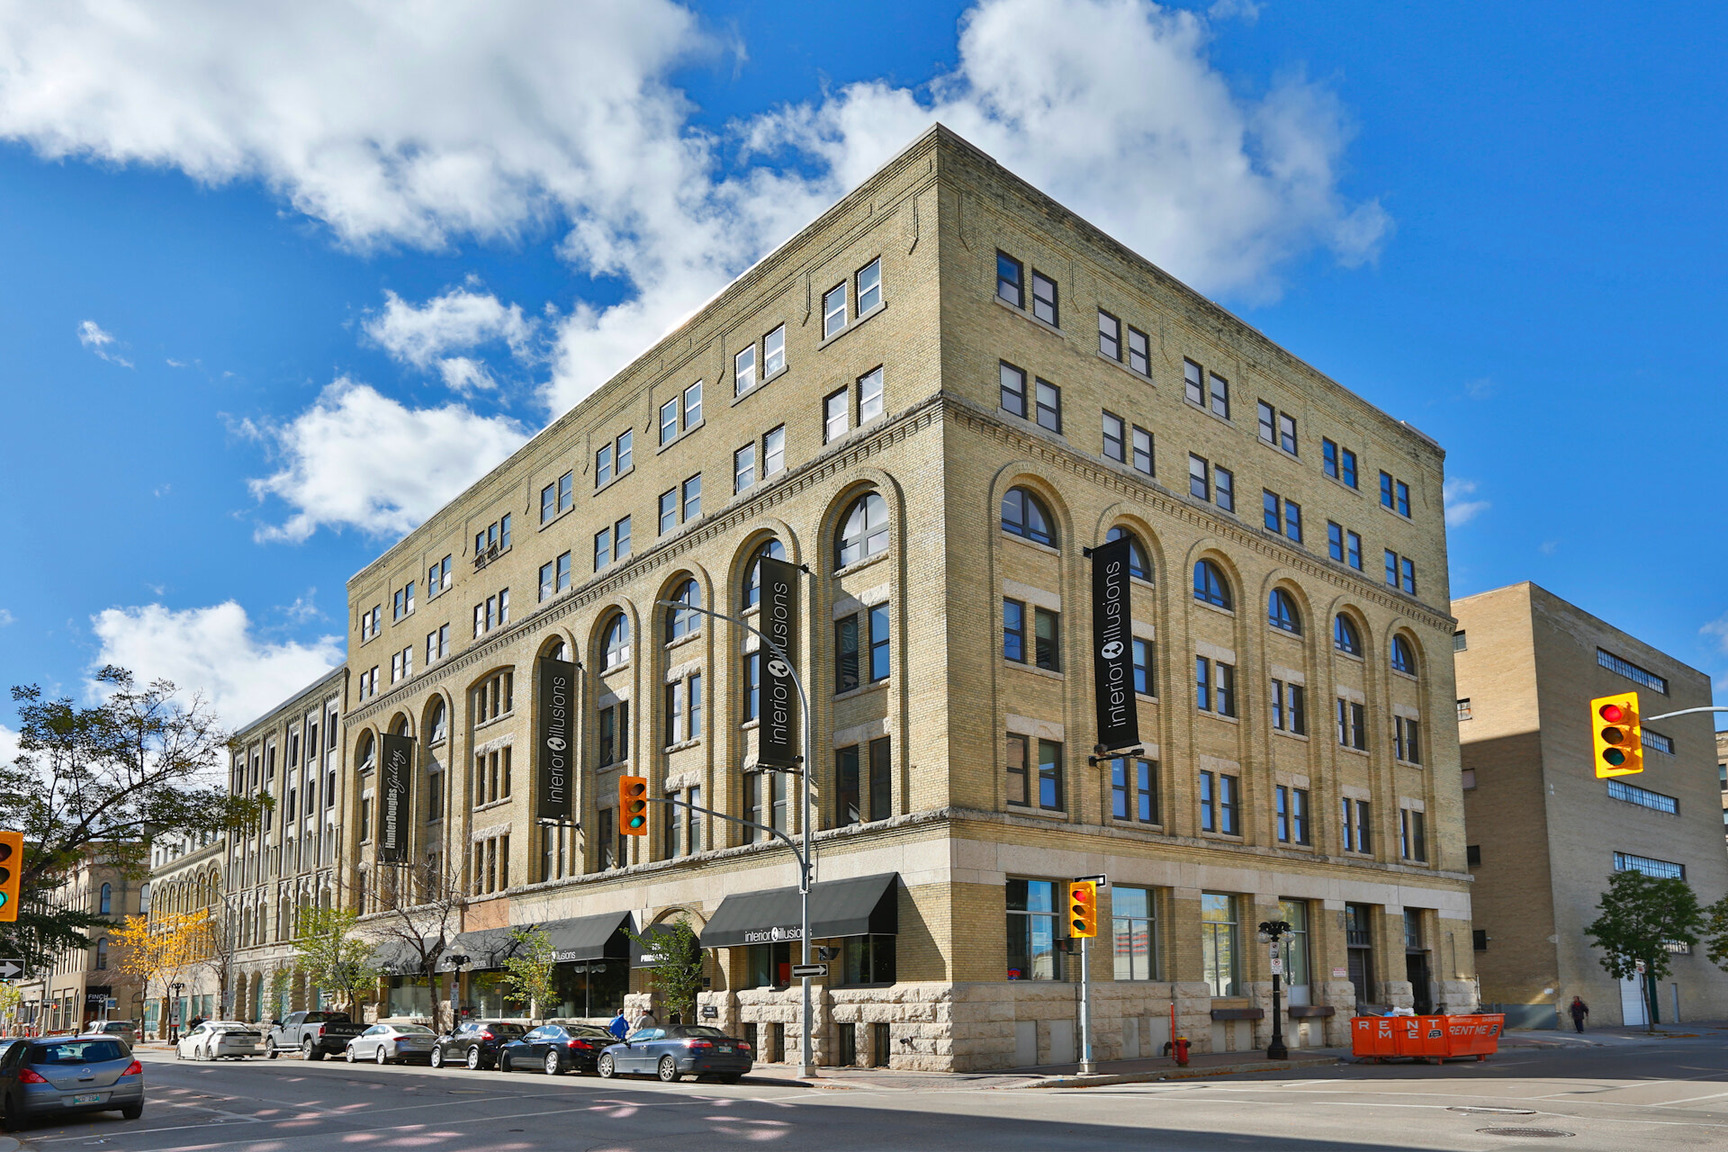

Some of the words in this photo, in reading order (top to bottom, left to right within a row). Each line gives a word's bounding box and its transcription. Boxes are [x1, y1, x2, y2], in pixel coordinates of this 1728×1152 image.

[1102, 560, 1121, 642] illusions
[549, 676, 566, 740] illusions
[769, 680, 787, 746] interior
[1105, 661, 1124, 728] interior
[547, 751, 564, 804] interior
[744, 929, 771, 942] interior
